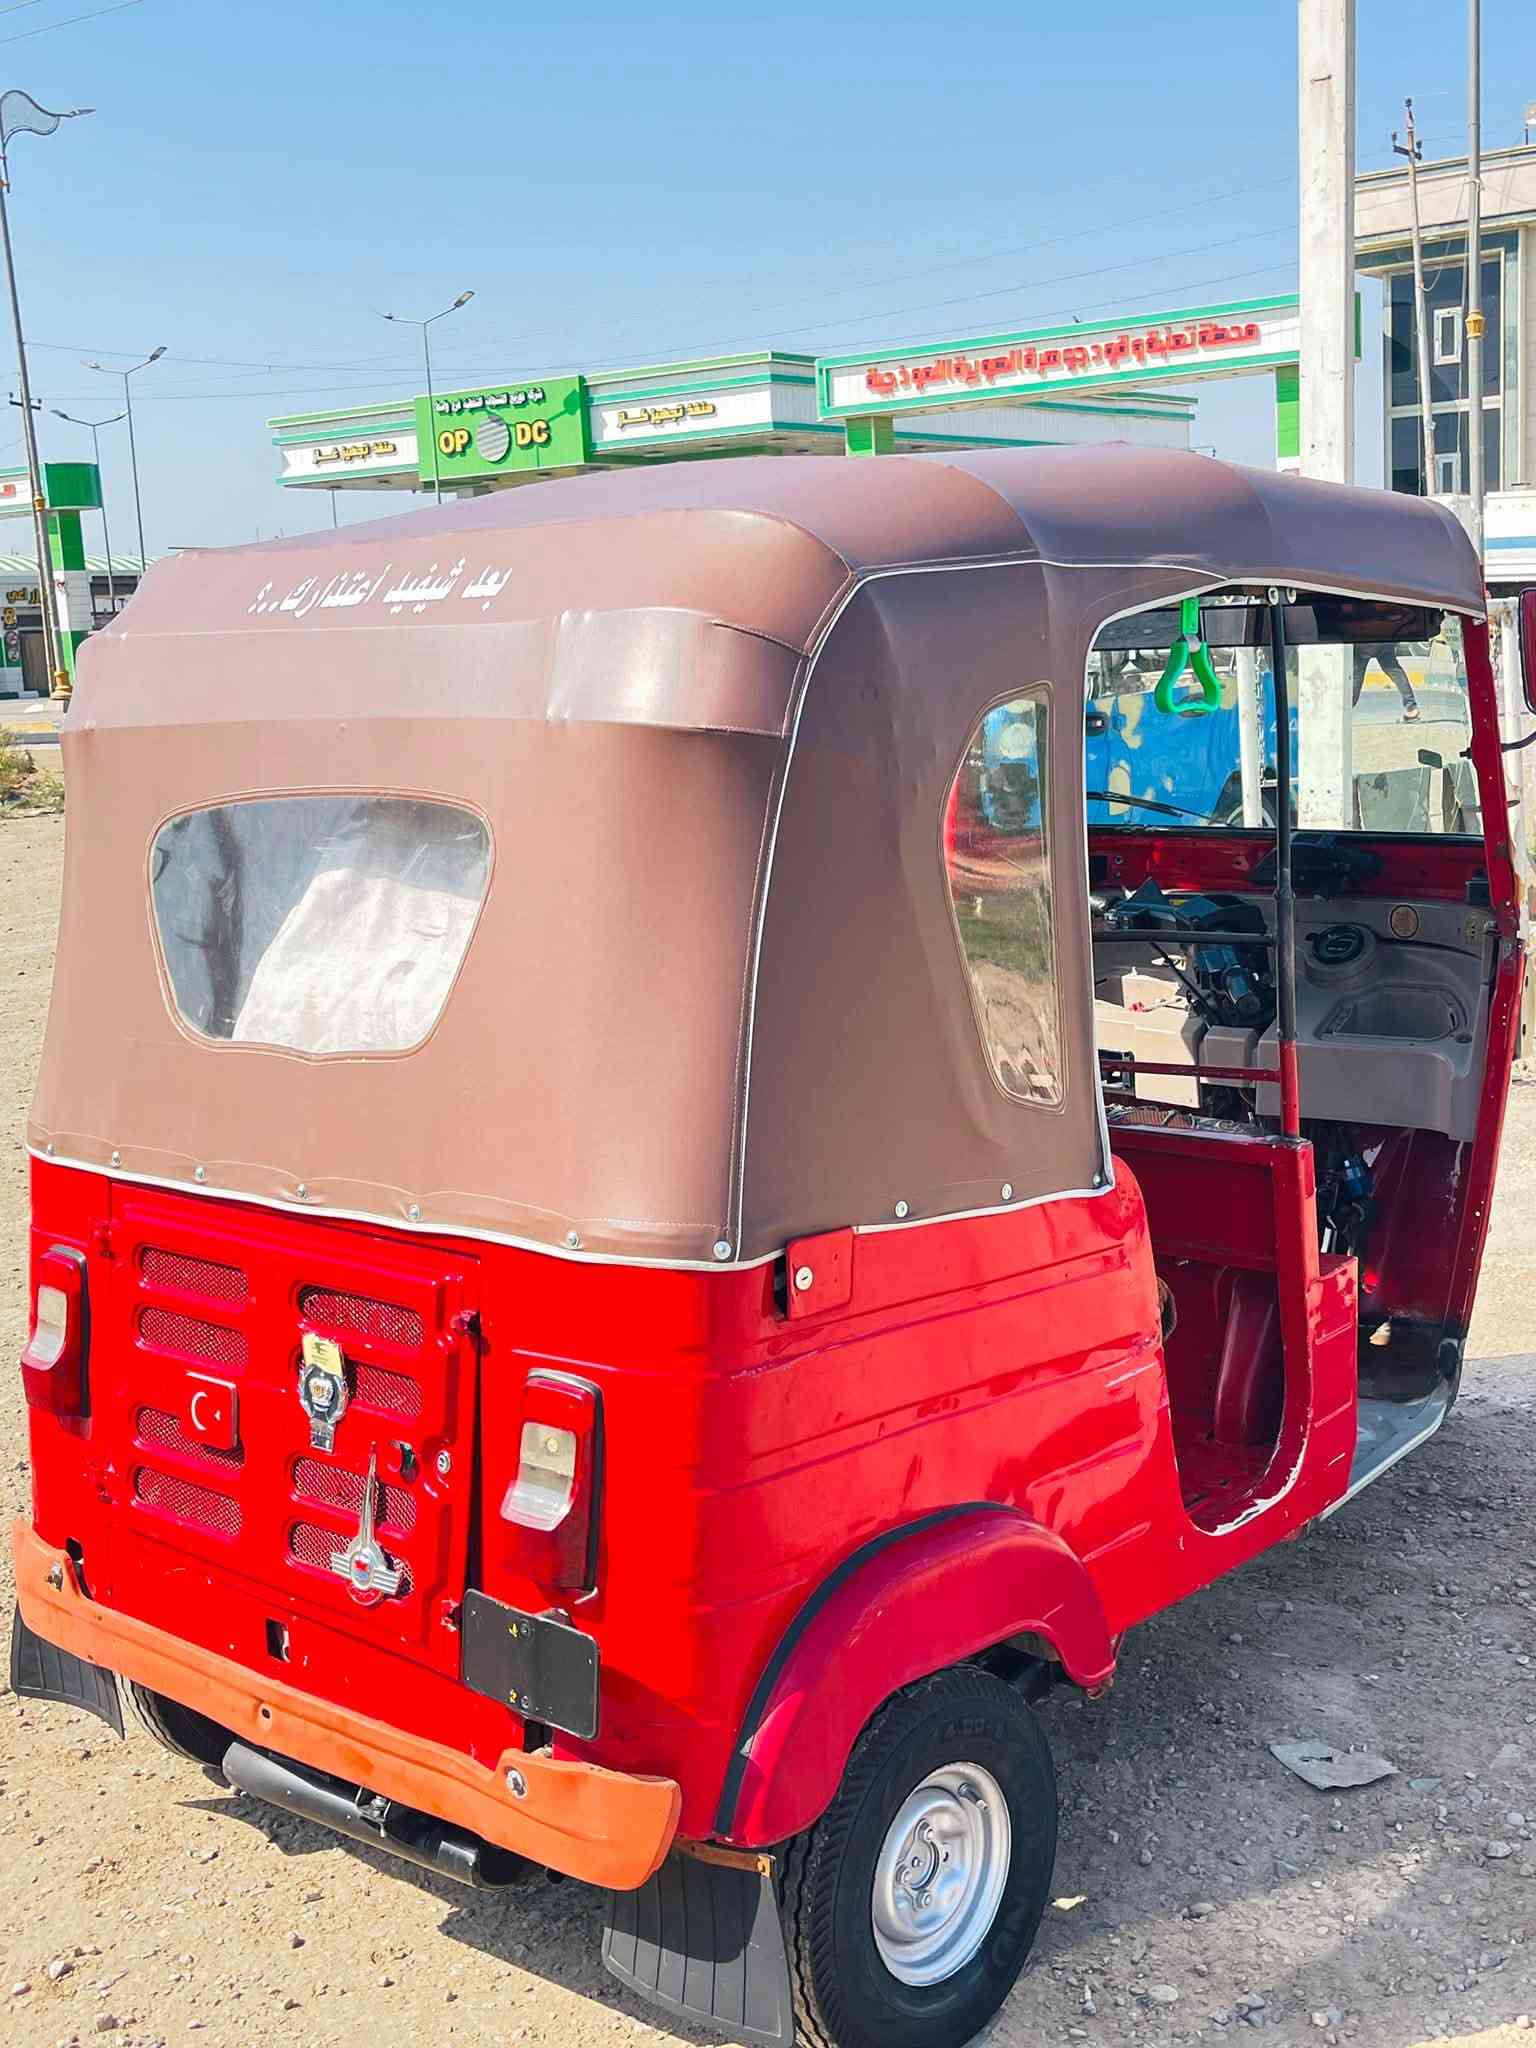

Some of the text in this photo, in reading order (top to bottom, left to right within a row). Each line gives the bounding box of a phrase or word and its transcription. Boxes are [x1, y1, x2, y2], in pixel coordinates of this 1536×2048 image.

[1199, 323, 1260, 347] محطة
[438, 420, 549, 454] OP DC
[462, 566, 512, 612] بعد
